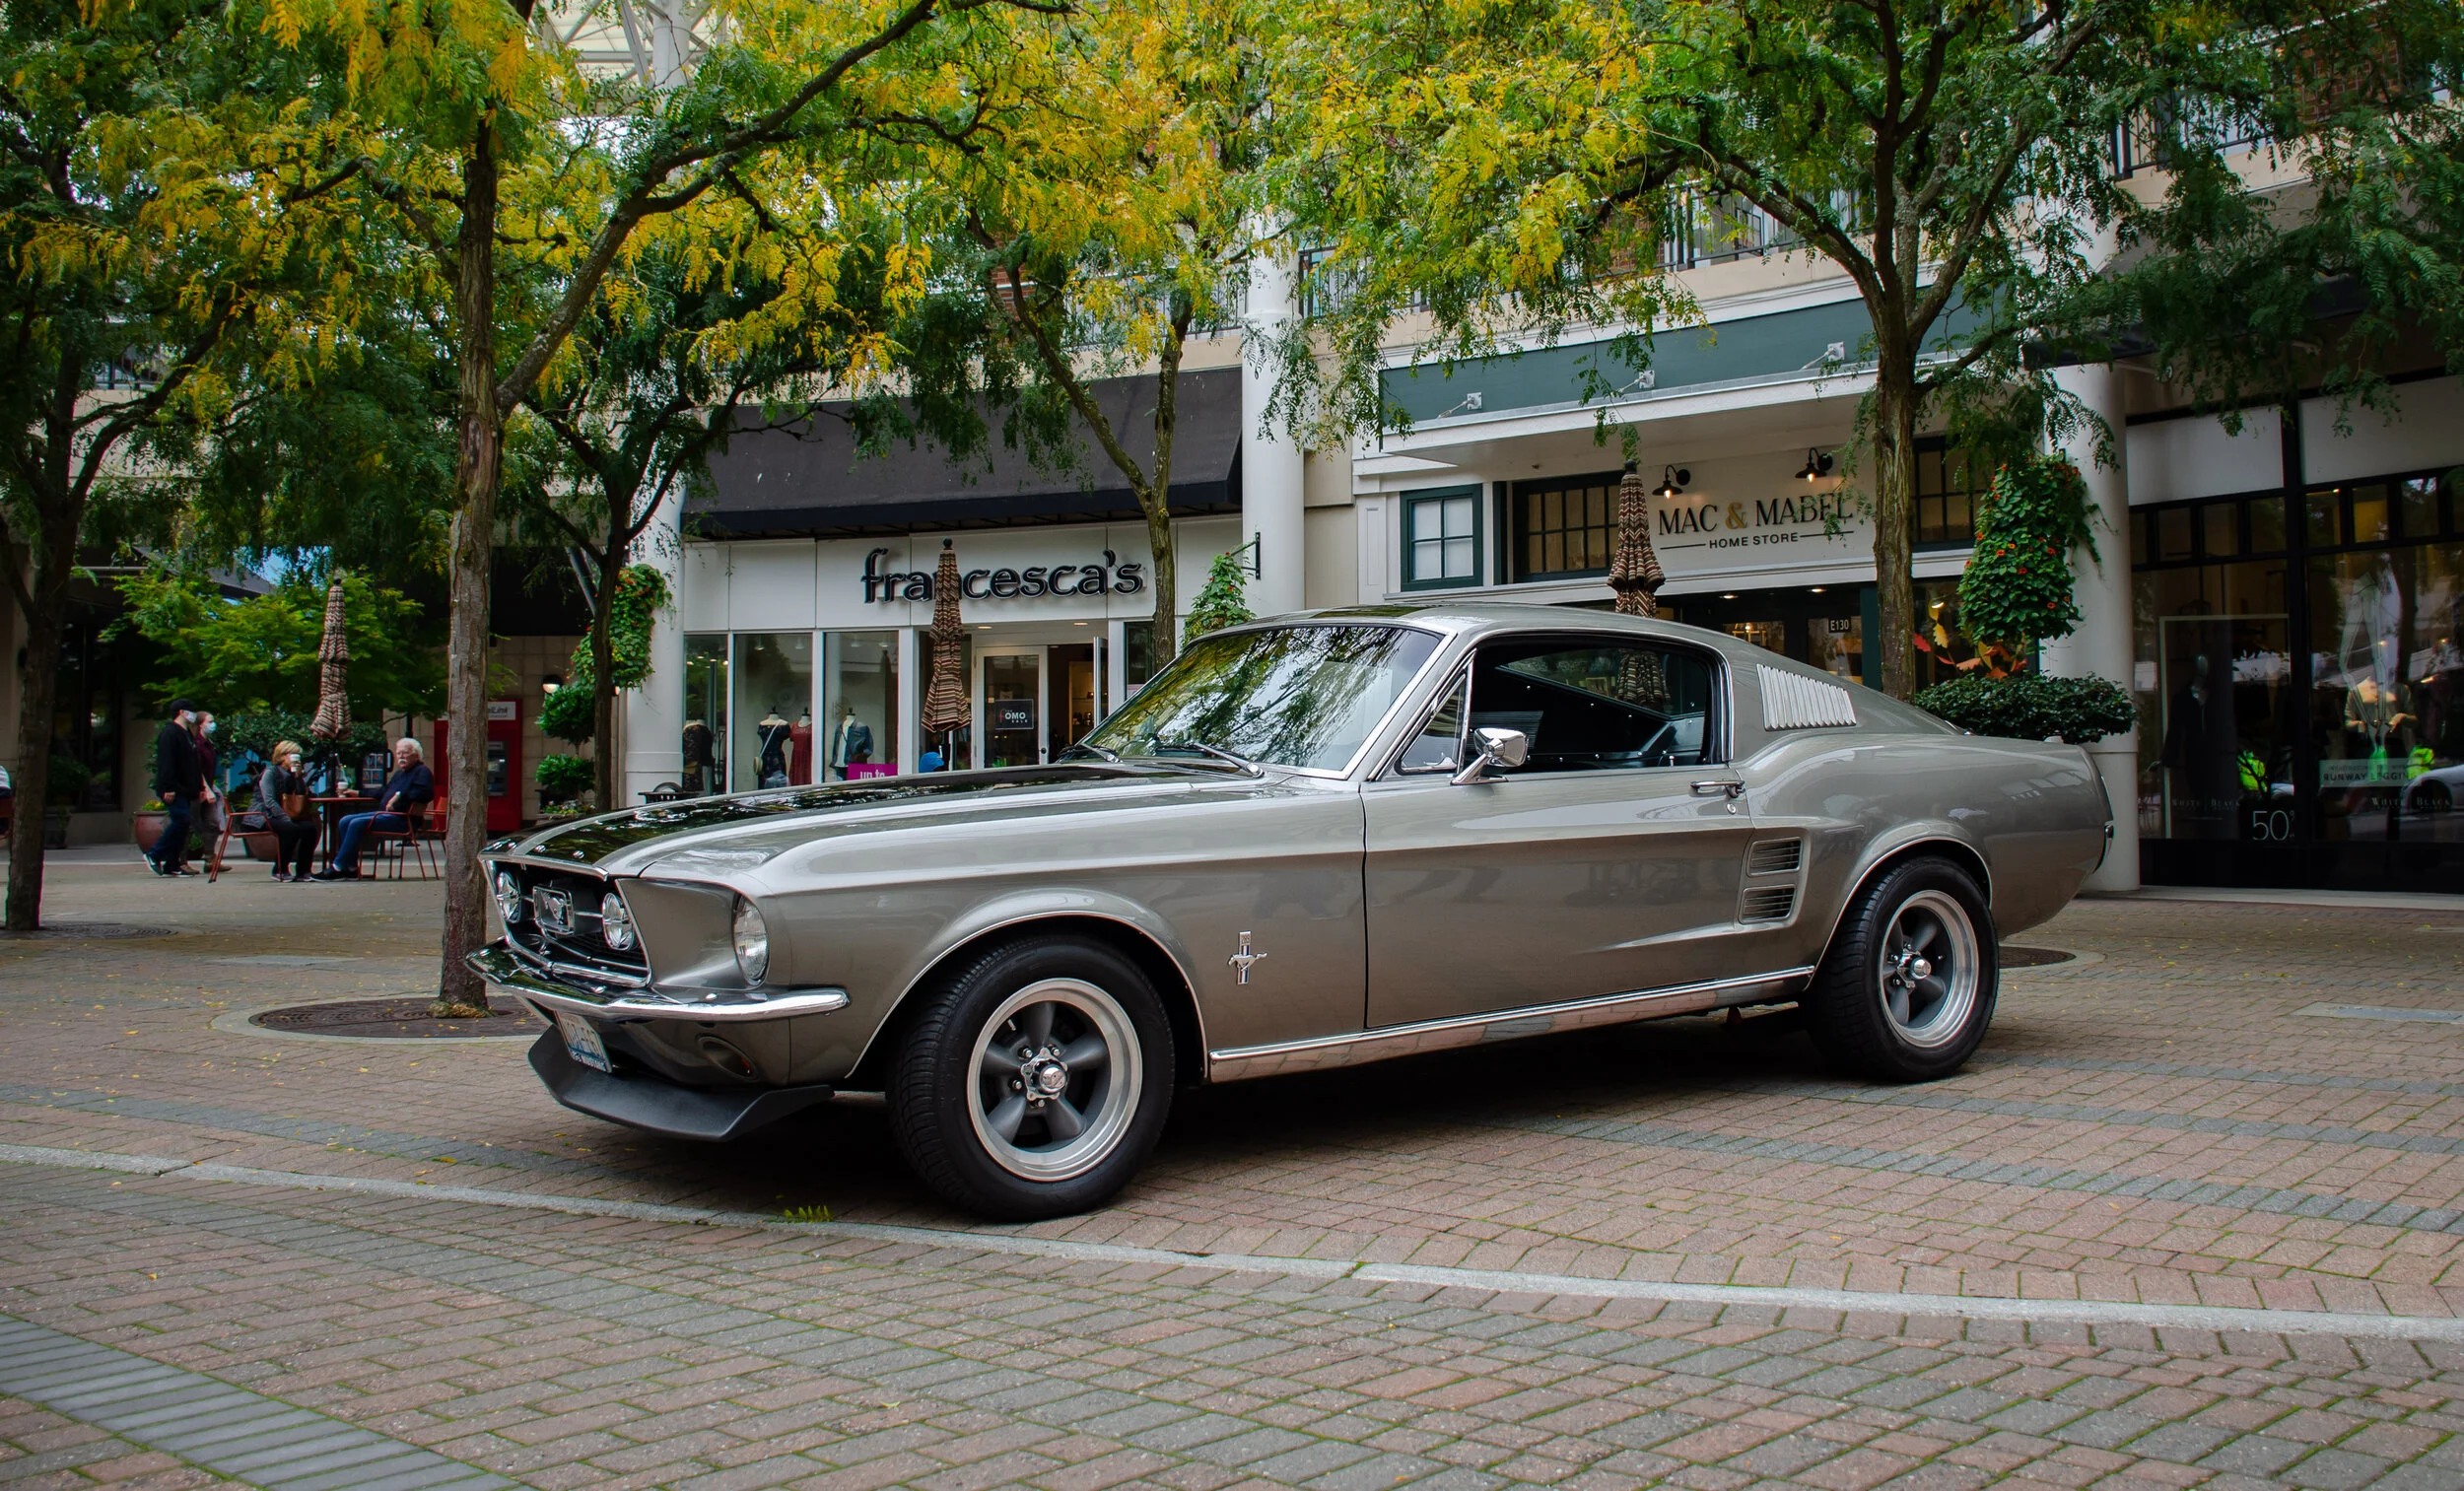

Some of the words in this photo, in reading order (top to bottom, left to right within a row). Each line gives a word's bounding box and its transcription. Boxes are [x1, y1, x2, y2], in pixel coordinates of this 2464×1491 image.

[1658, 504, 1718, 535] MAC
[1725, 501, 1748, 530] &
[1755, 491, 1854, 526] MABEL
[1709, 536, 1749, 549] HOME
[1752, 532, 1799, 545] STORE
[860, 547, 1145, 604] fracesca's
[1830, 619, 1849, 631] E130
